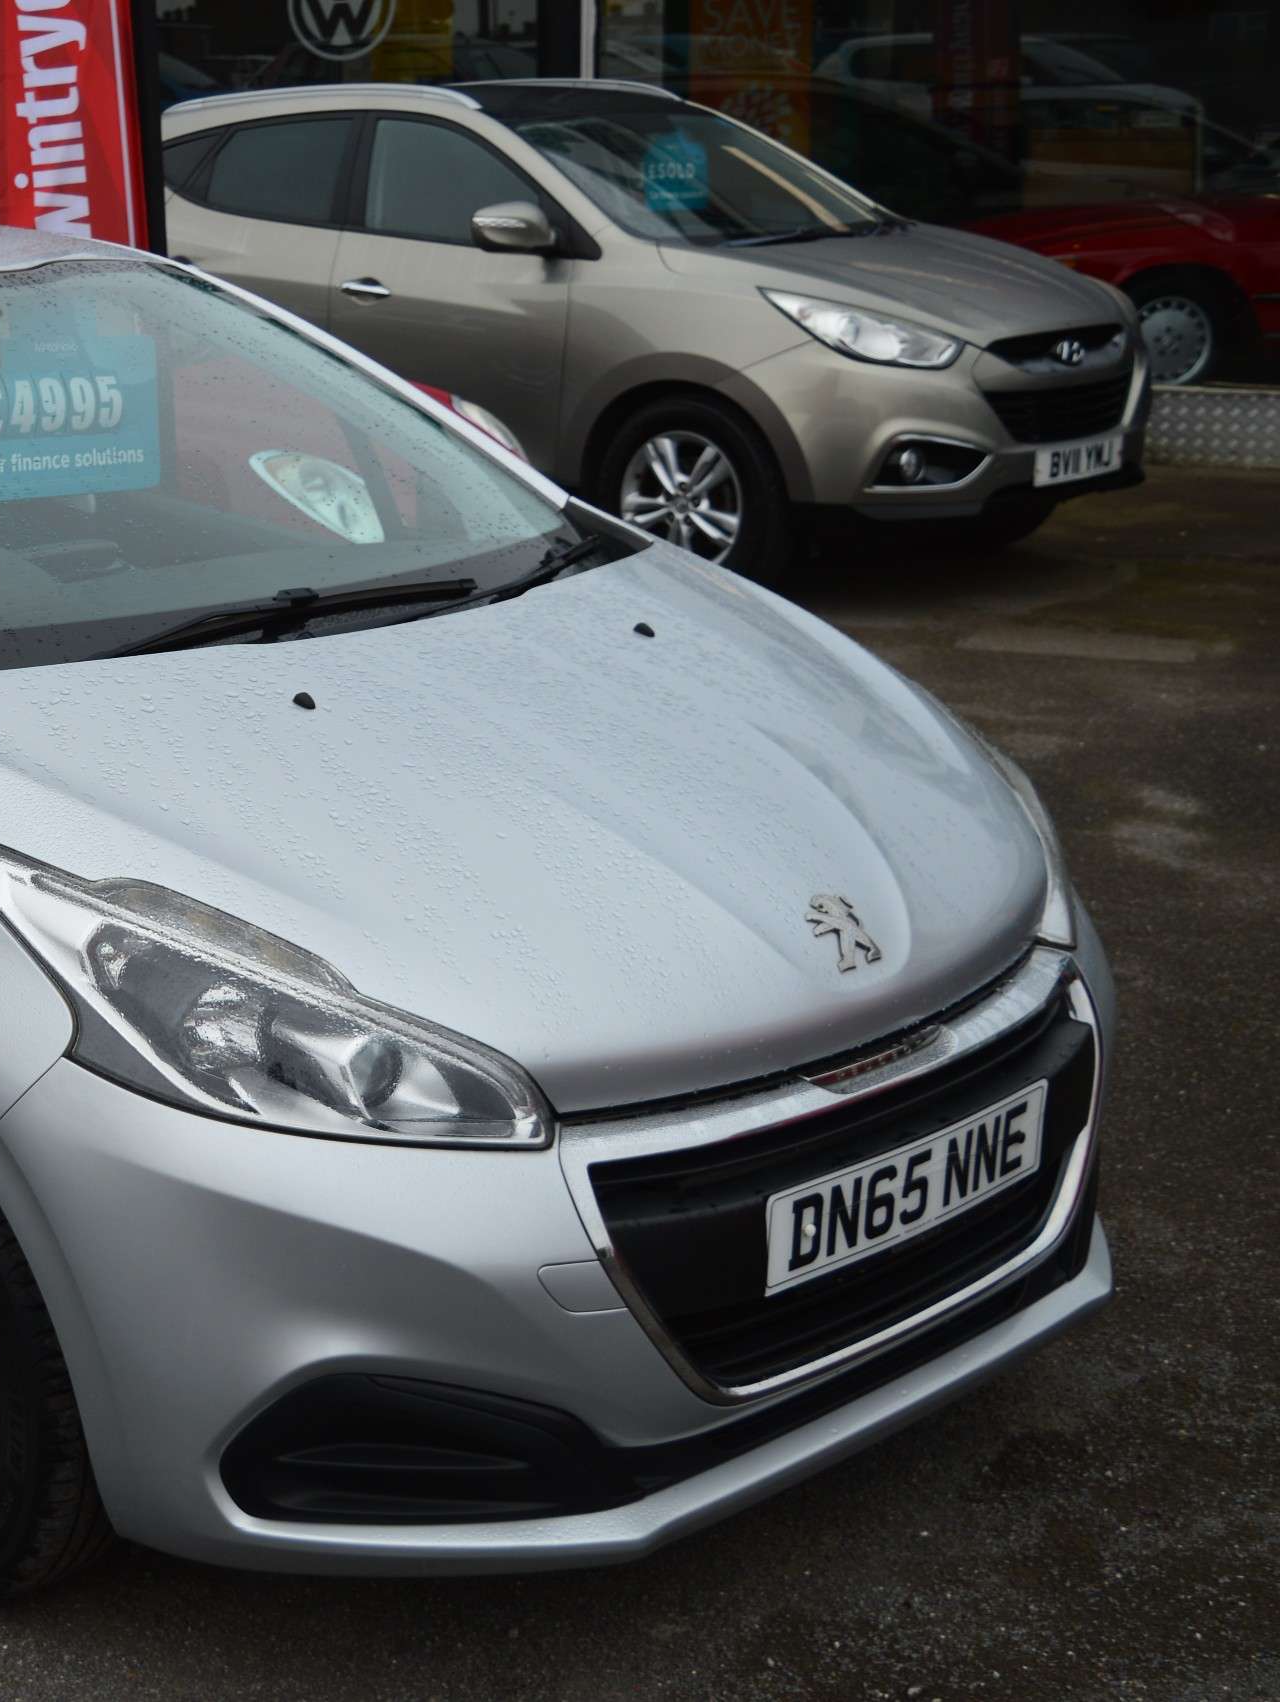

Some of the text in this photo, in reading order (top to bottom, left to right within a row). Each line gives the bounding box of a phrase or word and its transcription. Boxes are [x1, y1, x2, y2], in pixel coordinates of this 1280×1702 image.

[11, 452, 70, 473] finance
[75, 447, 145, 468] solutions
[787, 1101, 1029, 1272] DN65 NNE
